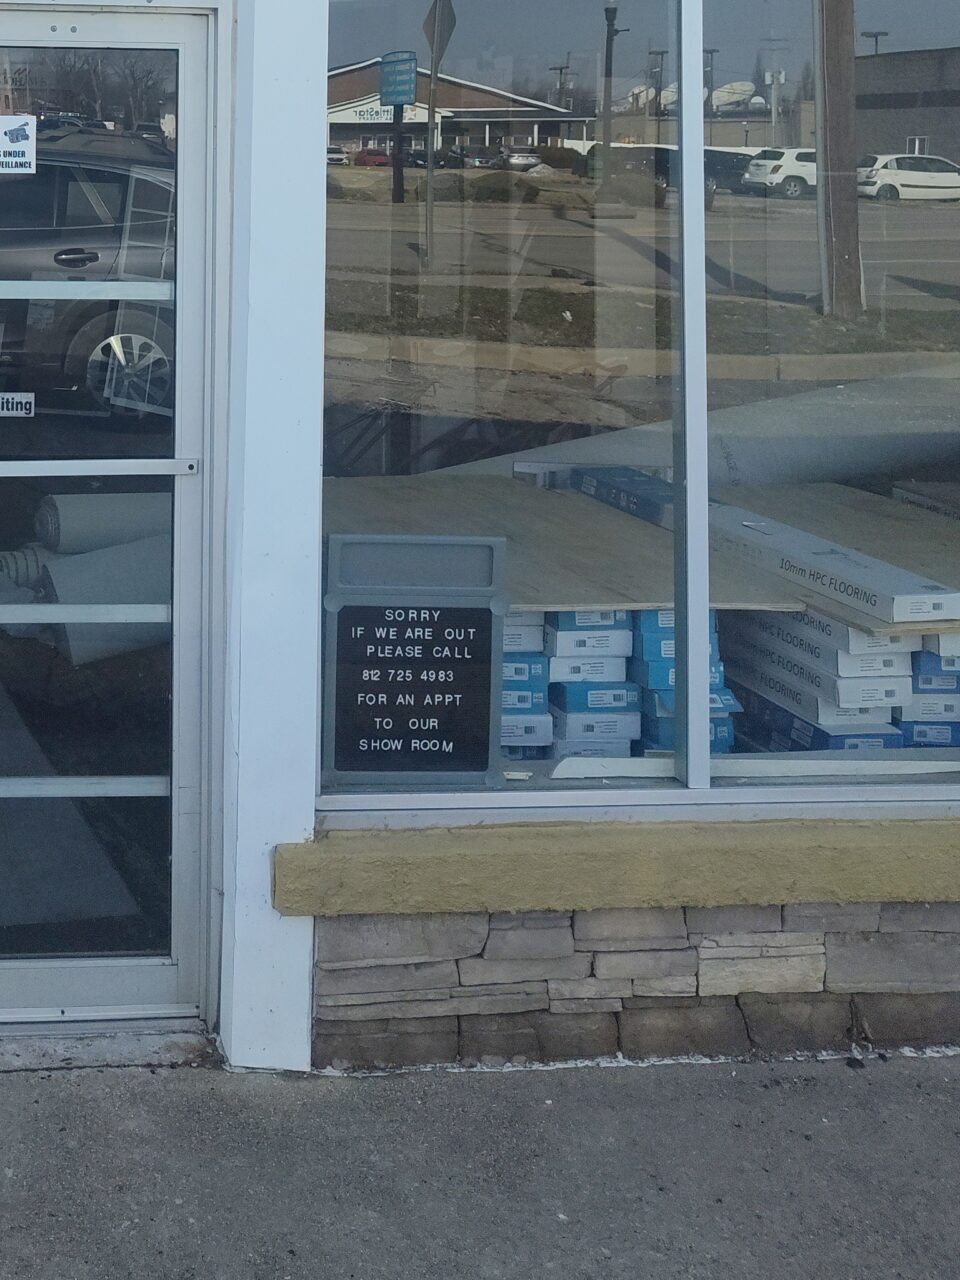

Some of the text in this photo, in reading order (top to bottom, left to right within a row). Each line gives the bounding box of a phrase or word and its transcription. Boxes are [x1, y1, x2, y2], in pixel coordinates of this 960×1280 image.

[2, 150, 26, 159] UNDER
[778, 557, 878, 608] 10mm HPC FLOORING
[384, 609, 441, 623] SORRY
[350, 627, 477, 641] IF WE ARE OUT
[776, 627, 821, 659] FLOORING
[366, 645, 472, 659] PLEASE CALL
[362, 670, 455, 683] 812 725 4983
[777, 655, 822, 688] FLOORING
[357, 693, 462, 706] FOR AN APPT
[374, 718, 439, 731] TO OUR
[359, 739, 454, 754] SHOW ROOM
